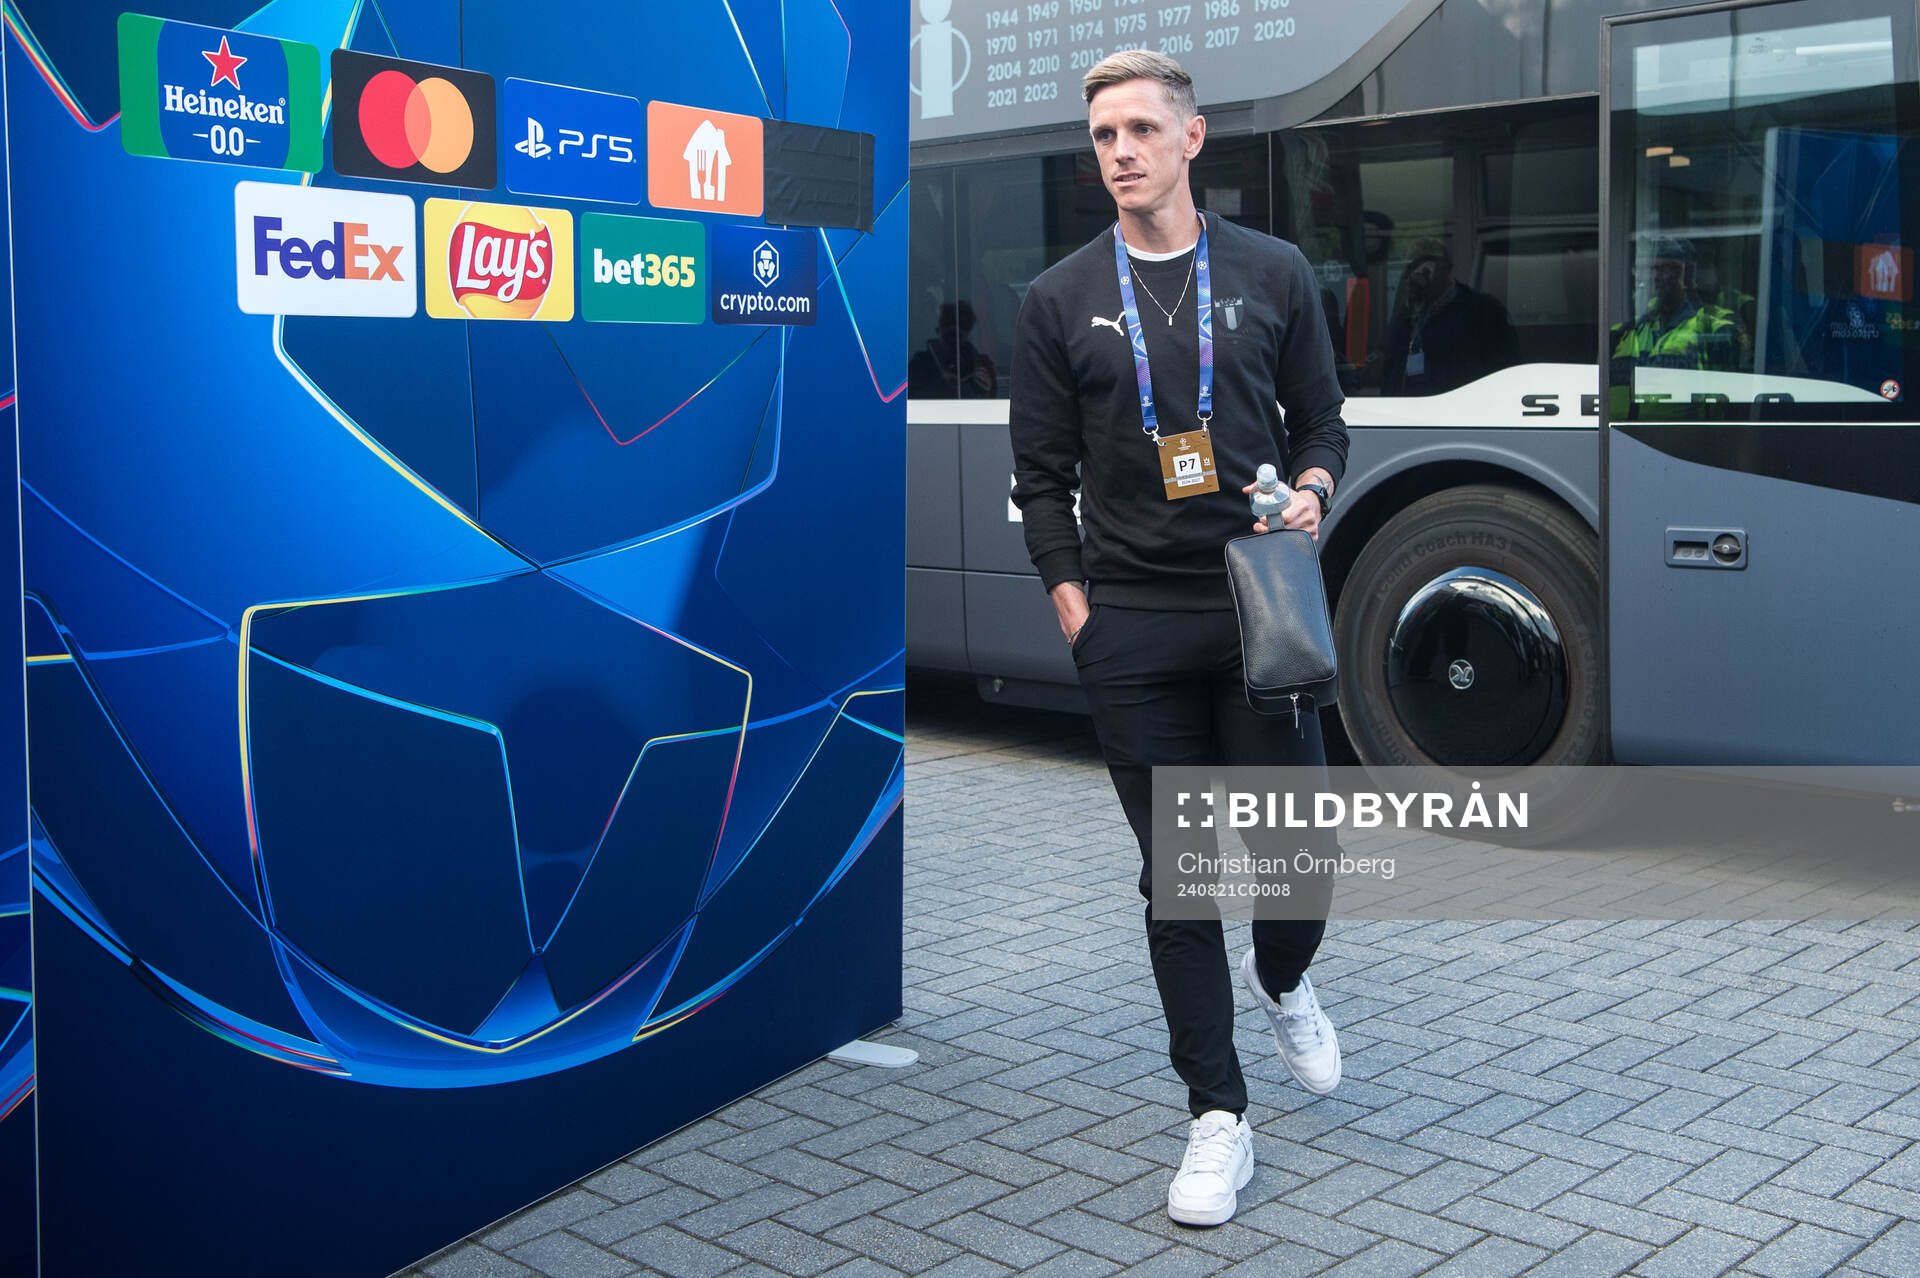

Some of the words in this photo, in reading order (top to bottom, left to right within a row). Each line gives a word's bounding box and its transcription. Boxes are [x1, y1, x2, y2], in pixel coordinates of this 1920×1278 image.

[985, 8, 1019, 30] 1944
[1027, 1, 1060, 23] 1949
[986, 35, 1017, 56] 1970
[1027, 28, 1058, 49] 1971
[1069, 20, 1104, 42] 1974
[1114, 13, 1147, 35] 1975
[1158, 6, 1192, 27] 1977
[1204, 0, 1240, 20] 1986
[987, 61, 1022, 82] 2004
[1028, 55, 1060, 76] 2010
[1071, 48, 1104, 69] 2013
[1159, 34, 1193, 55] 2016
[1204, 26, 1240, 49] 2017
[1253, 17, 1296, 42] 2020
[163, 84, 285, 125] Heineken
[987, 88, 1018, 108] 2021
[1023, 82, 1058, 102] 2023
[210, 125, 245, 156] 0.0
[558, 128, 634, 163] PS5
[253, 215, 405, 281] FedEx
[456, 224, 548, 302] Lay's
[593, 247, 696, 288] bet365
[720, 291, 810, 315] crypto.com
[1178, 458, 1196, 472] P7
[1414, 530, 1467, 557] Coach
[1471, 531, 1507, 551] HA3
